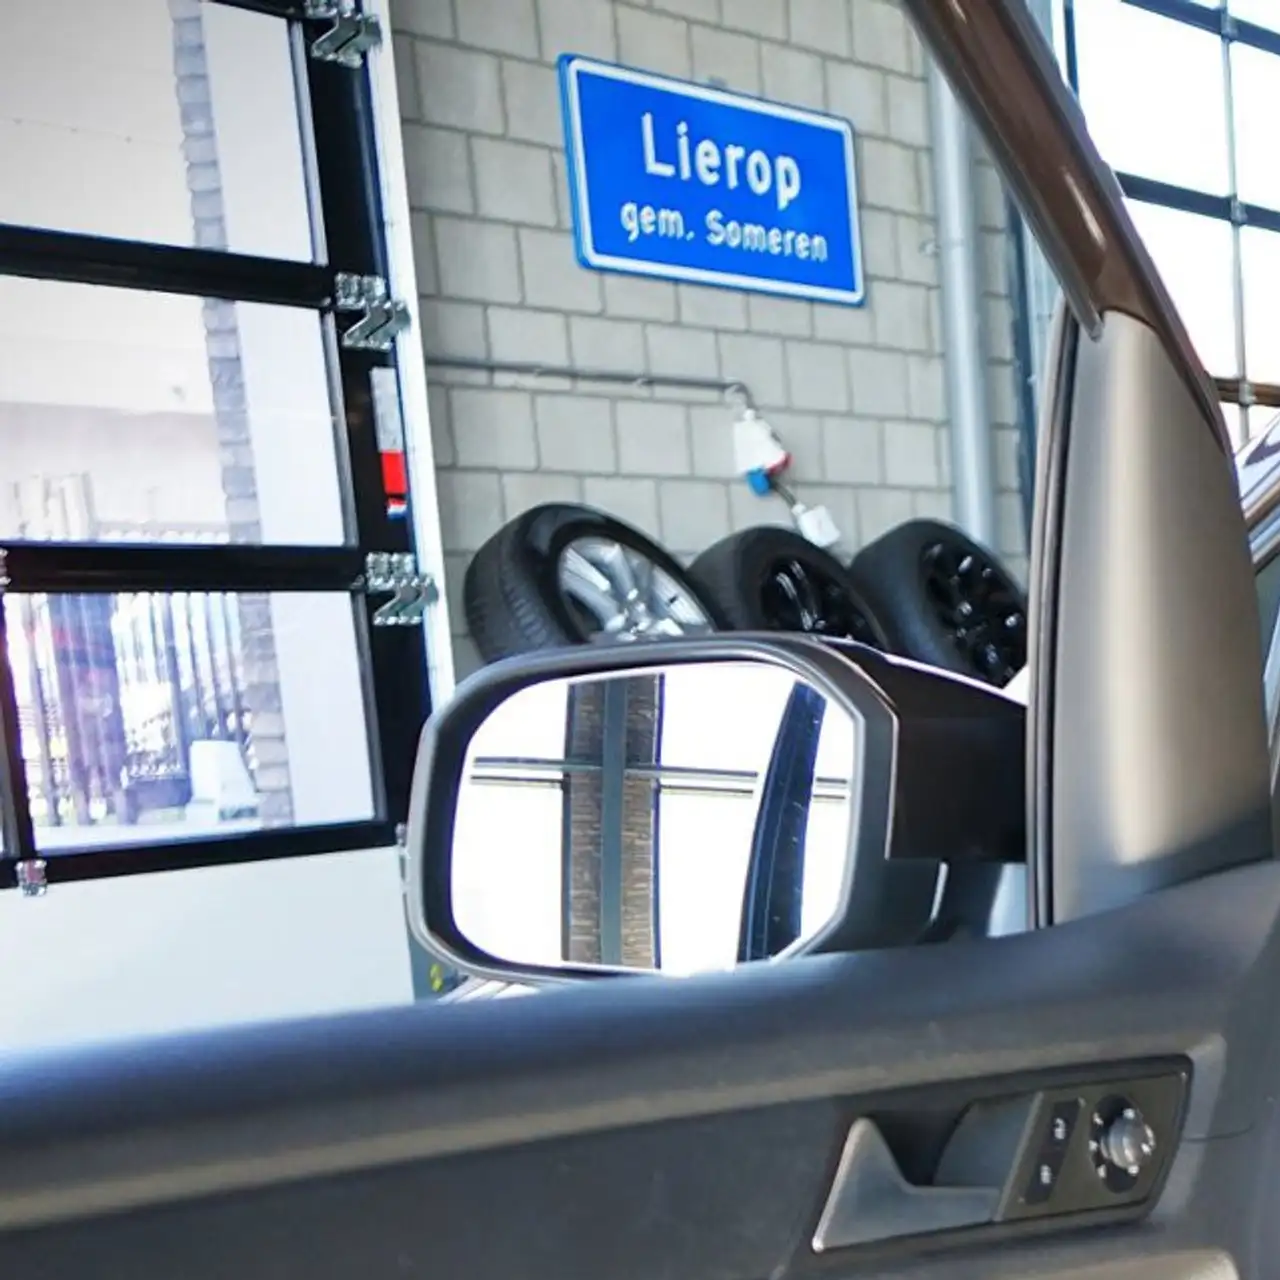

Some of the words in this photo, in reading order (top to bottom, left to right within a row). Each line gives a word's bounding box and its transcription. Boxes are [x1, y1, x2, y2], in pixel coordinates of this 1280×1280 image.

[641, 111, 801, 211] Lierop
[620, 201, 695, 242] gem.
[705, 208, 828, 263] Someren
